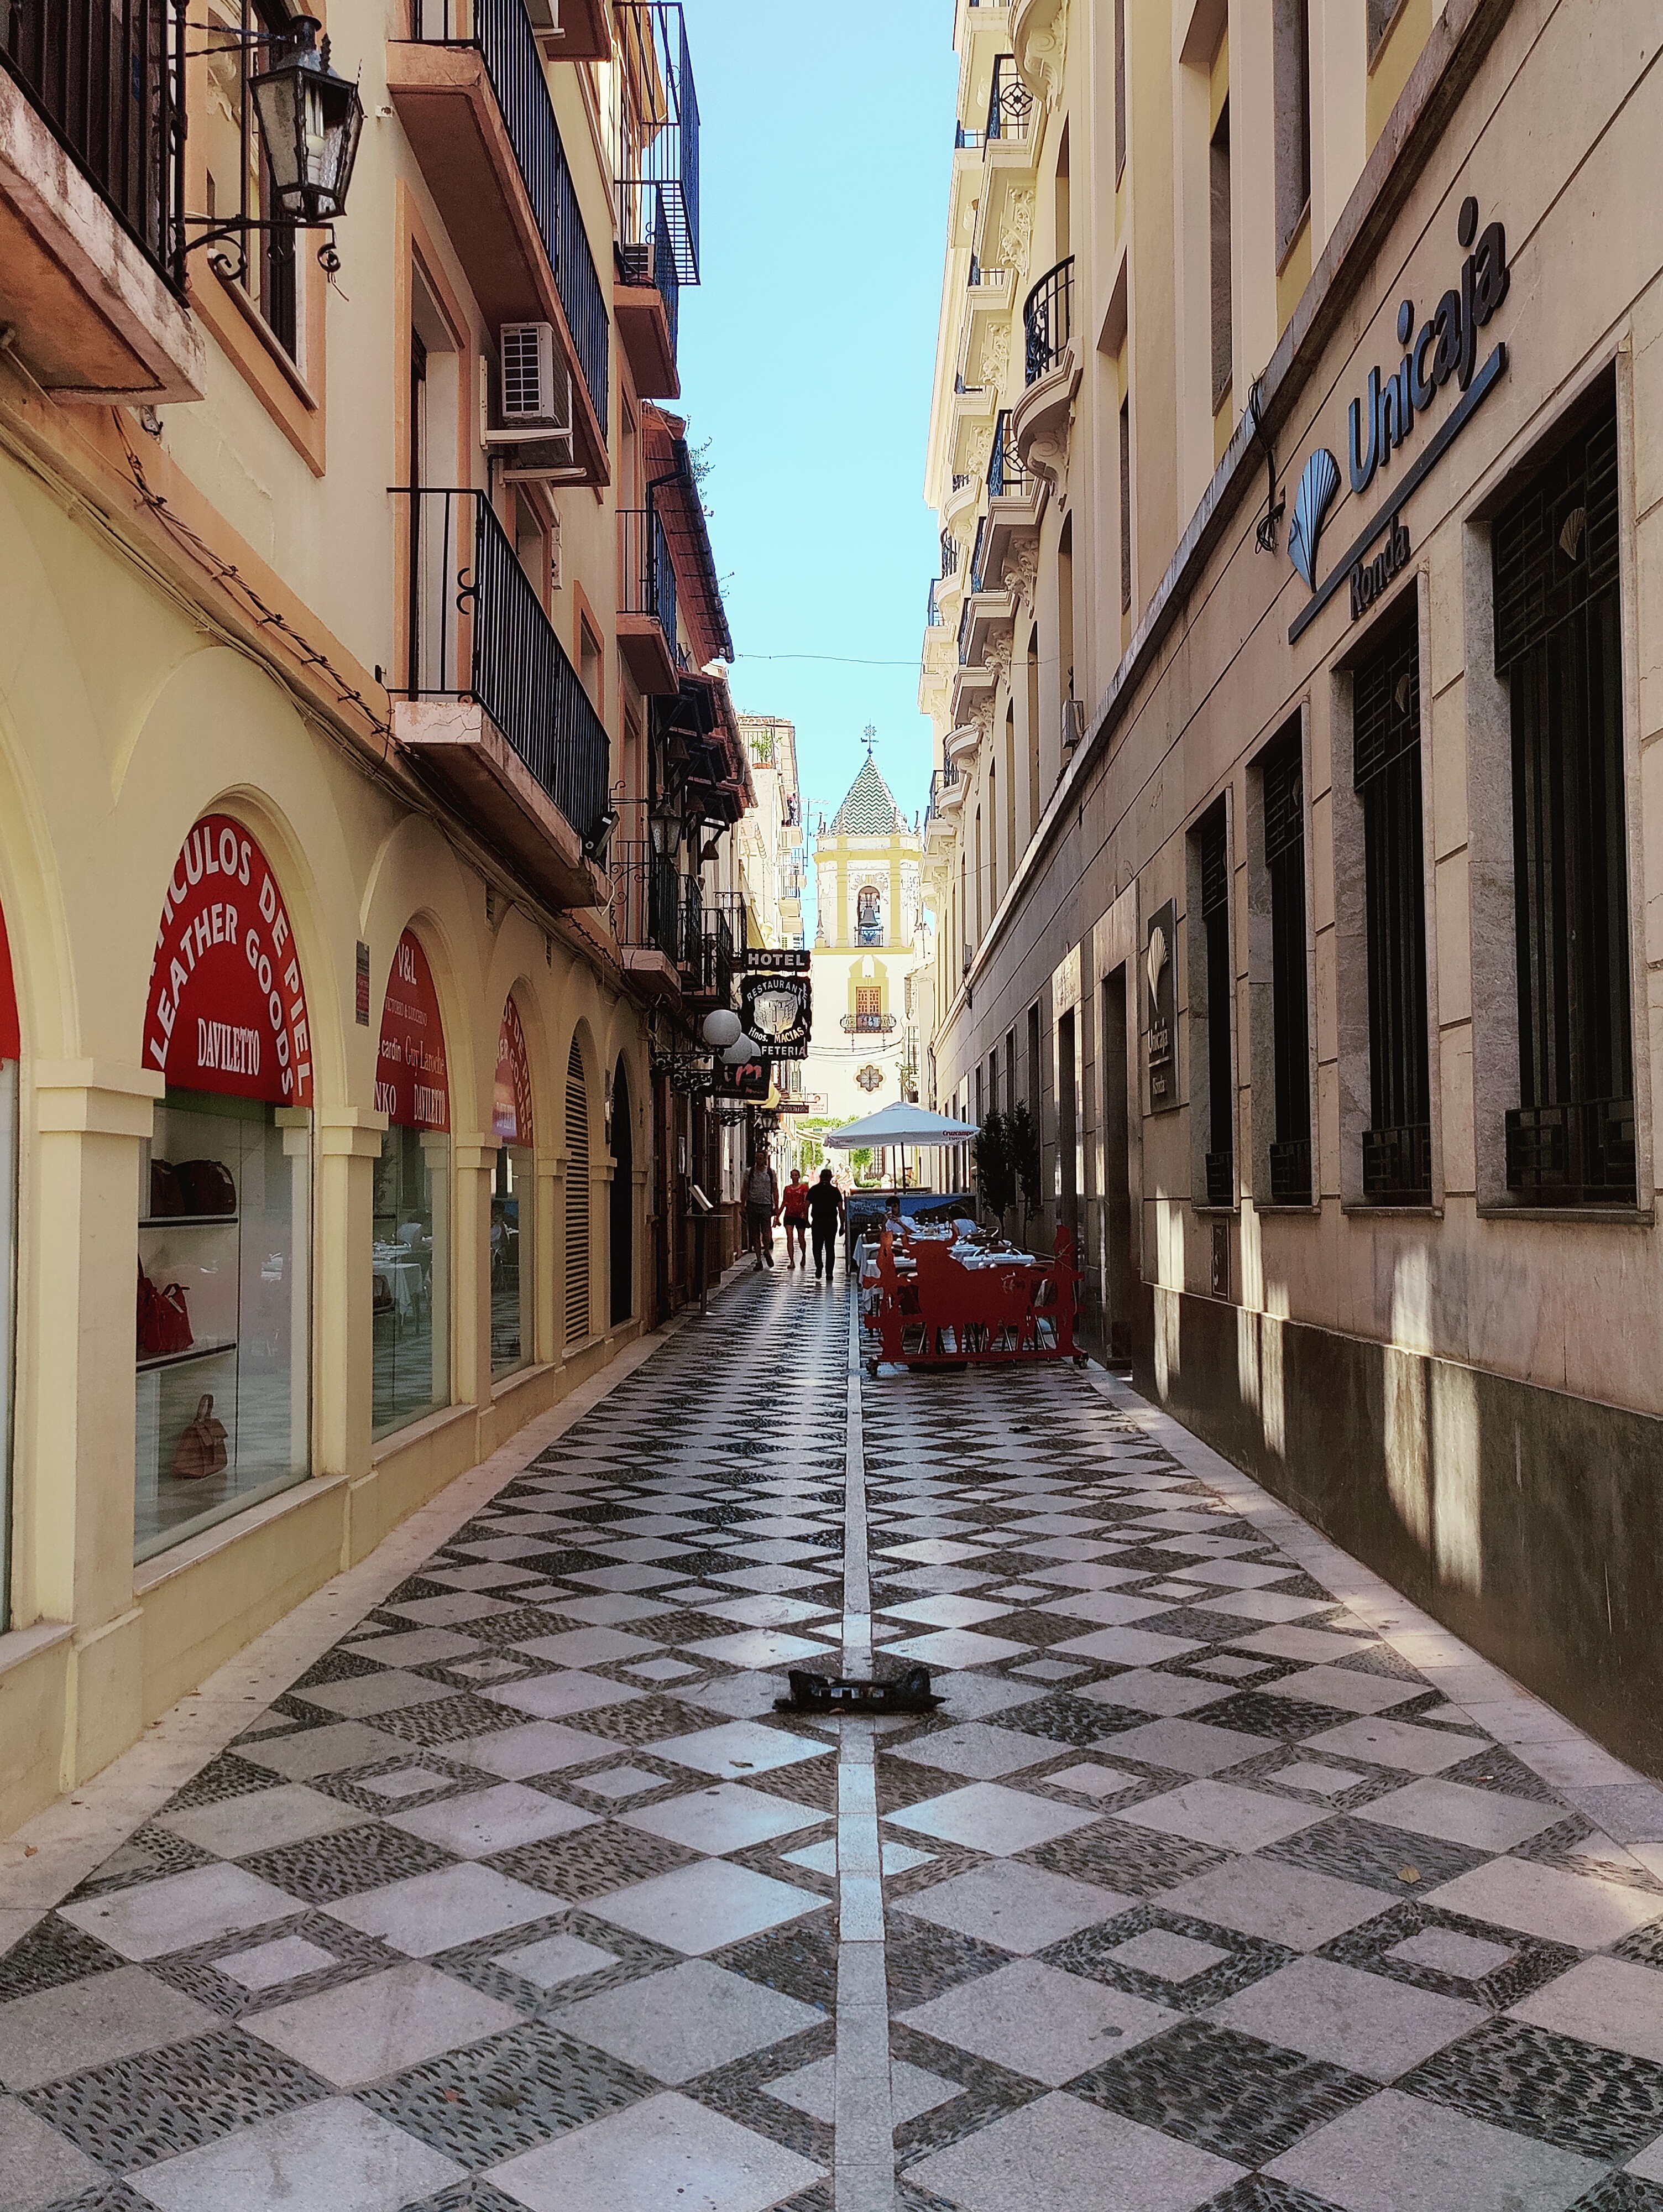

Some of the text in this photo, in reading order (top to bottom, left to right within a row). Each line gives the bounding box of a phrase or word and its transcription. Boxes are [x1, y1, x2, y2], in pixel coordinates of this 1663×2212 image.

[1348, 196, 1510, 494] Unicaja
[1350, 515, 1411, 620] Ronda
[150, 826, 311, 1097] ICULOS DE PIEL
[398, 943, 417, 985] V&L
[748, 953, 805, 966] HOTEL
[150, 903, 294, 1095] LEATHER GOODS
[747, 979, 808, 1002] RESTAURANTE
[198, 1018, 260, 1076] DAVILETTO
[381, 1035, 444, 1077] cardin Guy Laroche
[748, 1027, 805, 1044] Hnos. MACIAS
[762, 1046, 806, 1057] FETERIA
[375, 1081, 397, 1115] NKO
